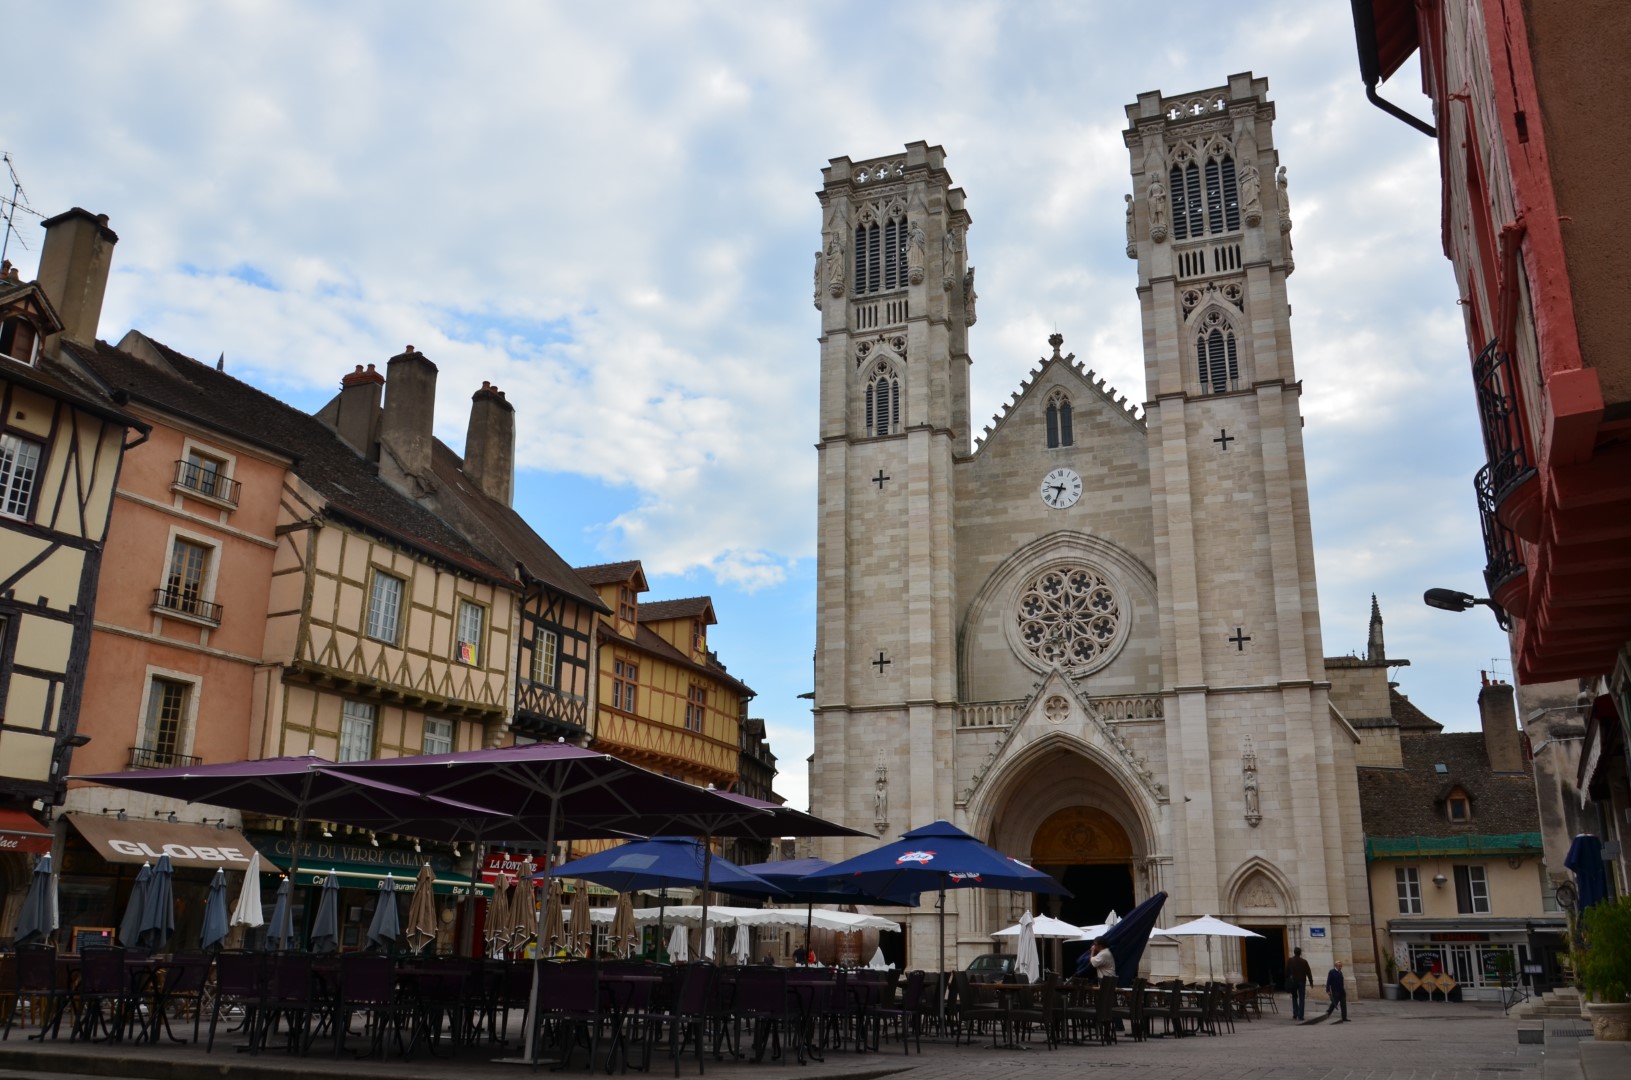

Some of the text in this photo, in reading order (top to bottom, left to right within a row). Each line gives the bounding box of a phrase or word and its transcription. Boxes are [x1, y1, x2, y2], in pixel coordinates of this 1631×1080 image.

[108, 839, 250, 862] GLOBE
[317, 843, 336, 859] DU
[342, 846, 384, 864] VERRE
[389, 851, 433, 867] GALANT
[489, 859, 538, 872] LA FONTNE
[452, 886, 464, 895] Bar
